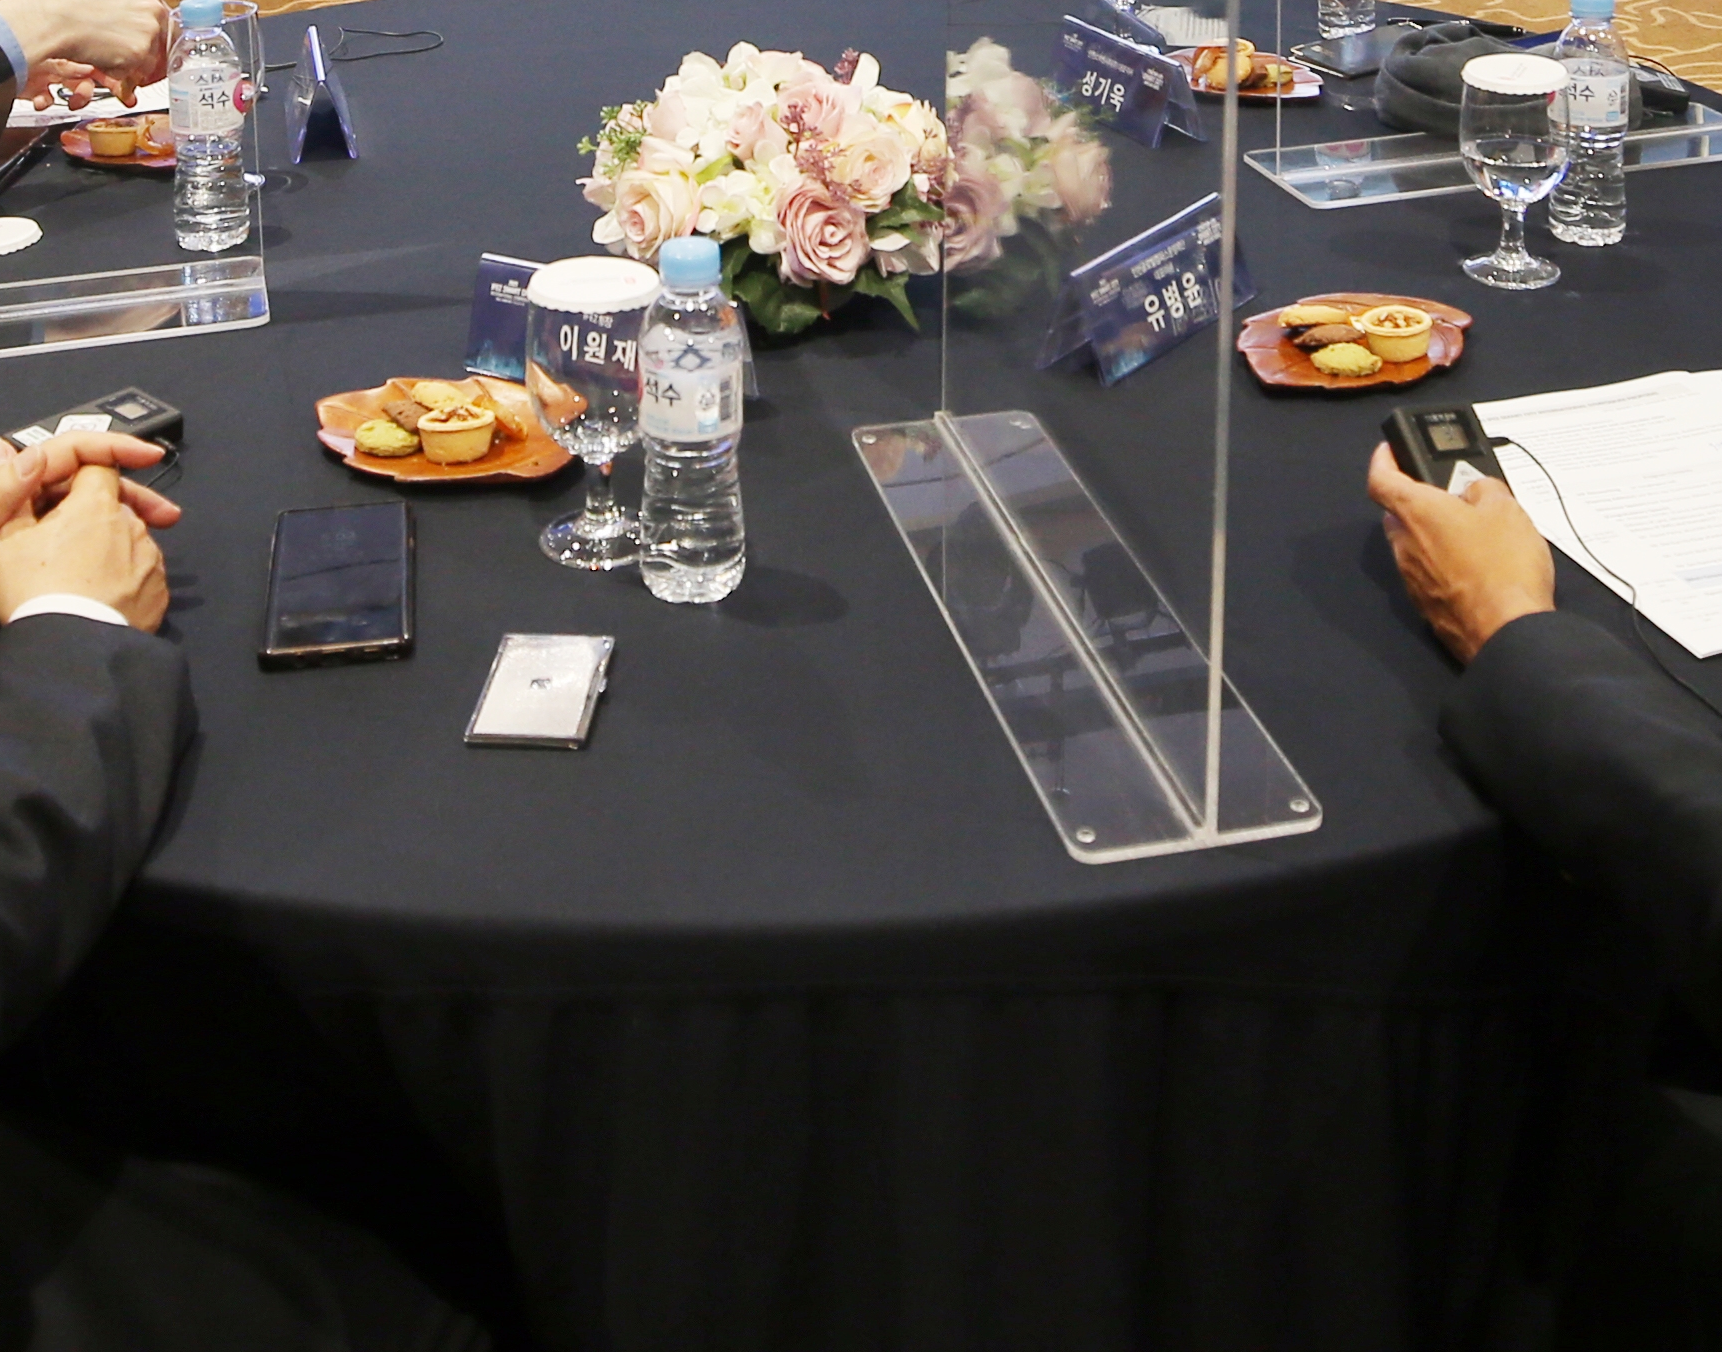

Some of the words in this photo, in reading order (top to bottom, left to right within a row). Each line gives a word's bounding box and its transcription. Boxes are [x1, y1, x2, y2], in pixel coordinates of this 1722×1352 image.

[199, 90, 230, 109] 석수
[1081, 70, 1125, 112] 성기욱
[1143, 271, 1203, 333] 유병윤
[560, 324, 637, 372] 이원재
